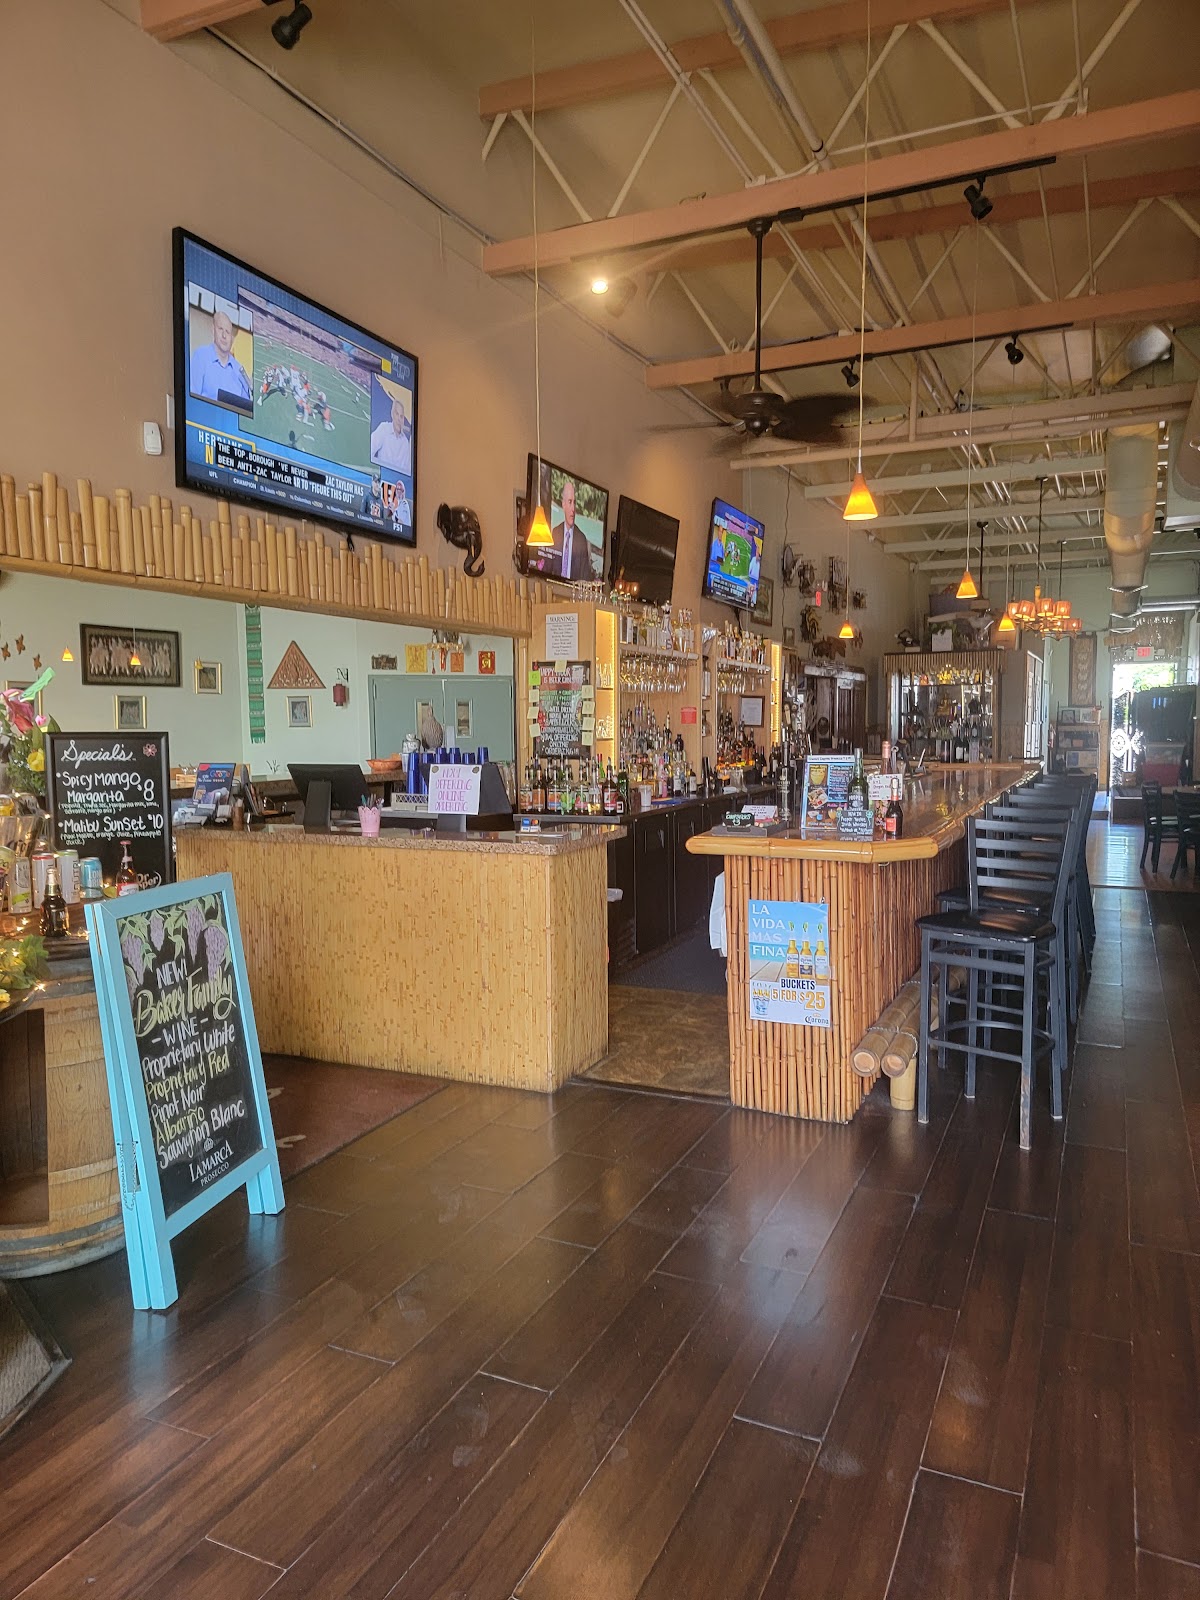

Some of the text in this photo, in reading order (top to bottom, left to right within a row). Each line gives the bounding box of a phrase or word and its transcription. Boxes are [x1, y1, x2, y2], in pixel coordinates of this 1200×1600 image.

[218, 442, 230, 454] THE
[290, 466, 309, 479] NEVER
[218, 455, 235, 468] BEEN
[237, 461, 268, 478] ANTI-ZAC
[270, 471, 292, 485] TAYLOR
[233, 478, 256, 489] CHAMPION
[302, 479, 309, 490] TO
[331, 488, 342, 501] THIS
[325, 475, 364, 497] ZAC TAYLOR HAS
[393, 523, 403, 532] FS1
[62, 771, 141, 791] Spicy Mango
[436, 779, 472, 790] OFFERING
[66, 790, 124, 804] Margarita
[438, 790, 466, 801] ONLINE
[752, 904, 770, 915] LA
[752, 918, 786, 930] VIDA
[752, 945, 786, 958] FINA
[155, 958, 188, 989] NEW!
[780, 978, 816, 990] BUCKETS
[186, 965, 237, 1020] Family
[772, 989, 826, 1009] 5 FOR $25
[804, 1015, 829, 1024] Corona
[203, 1021, 236, 1053] White
[207, 1046, 230, 1079] Red
[150, 1082, 206, 1126] Pinot Noir
[211, 1099, 246, 1132] Blanc
[155, 1106, 205, 1147] Albariño
[200, 1161, 230, 1187] PROSECCO
